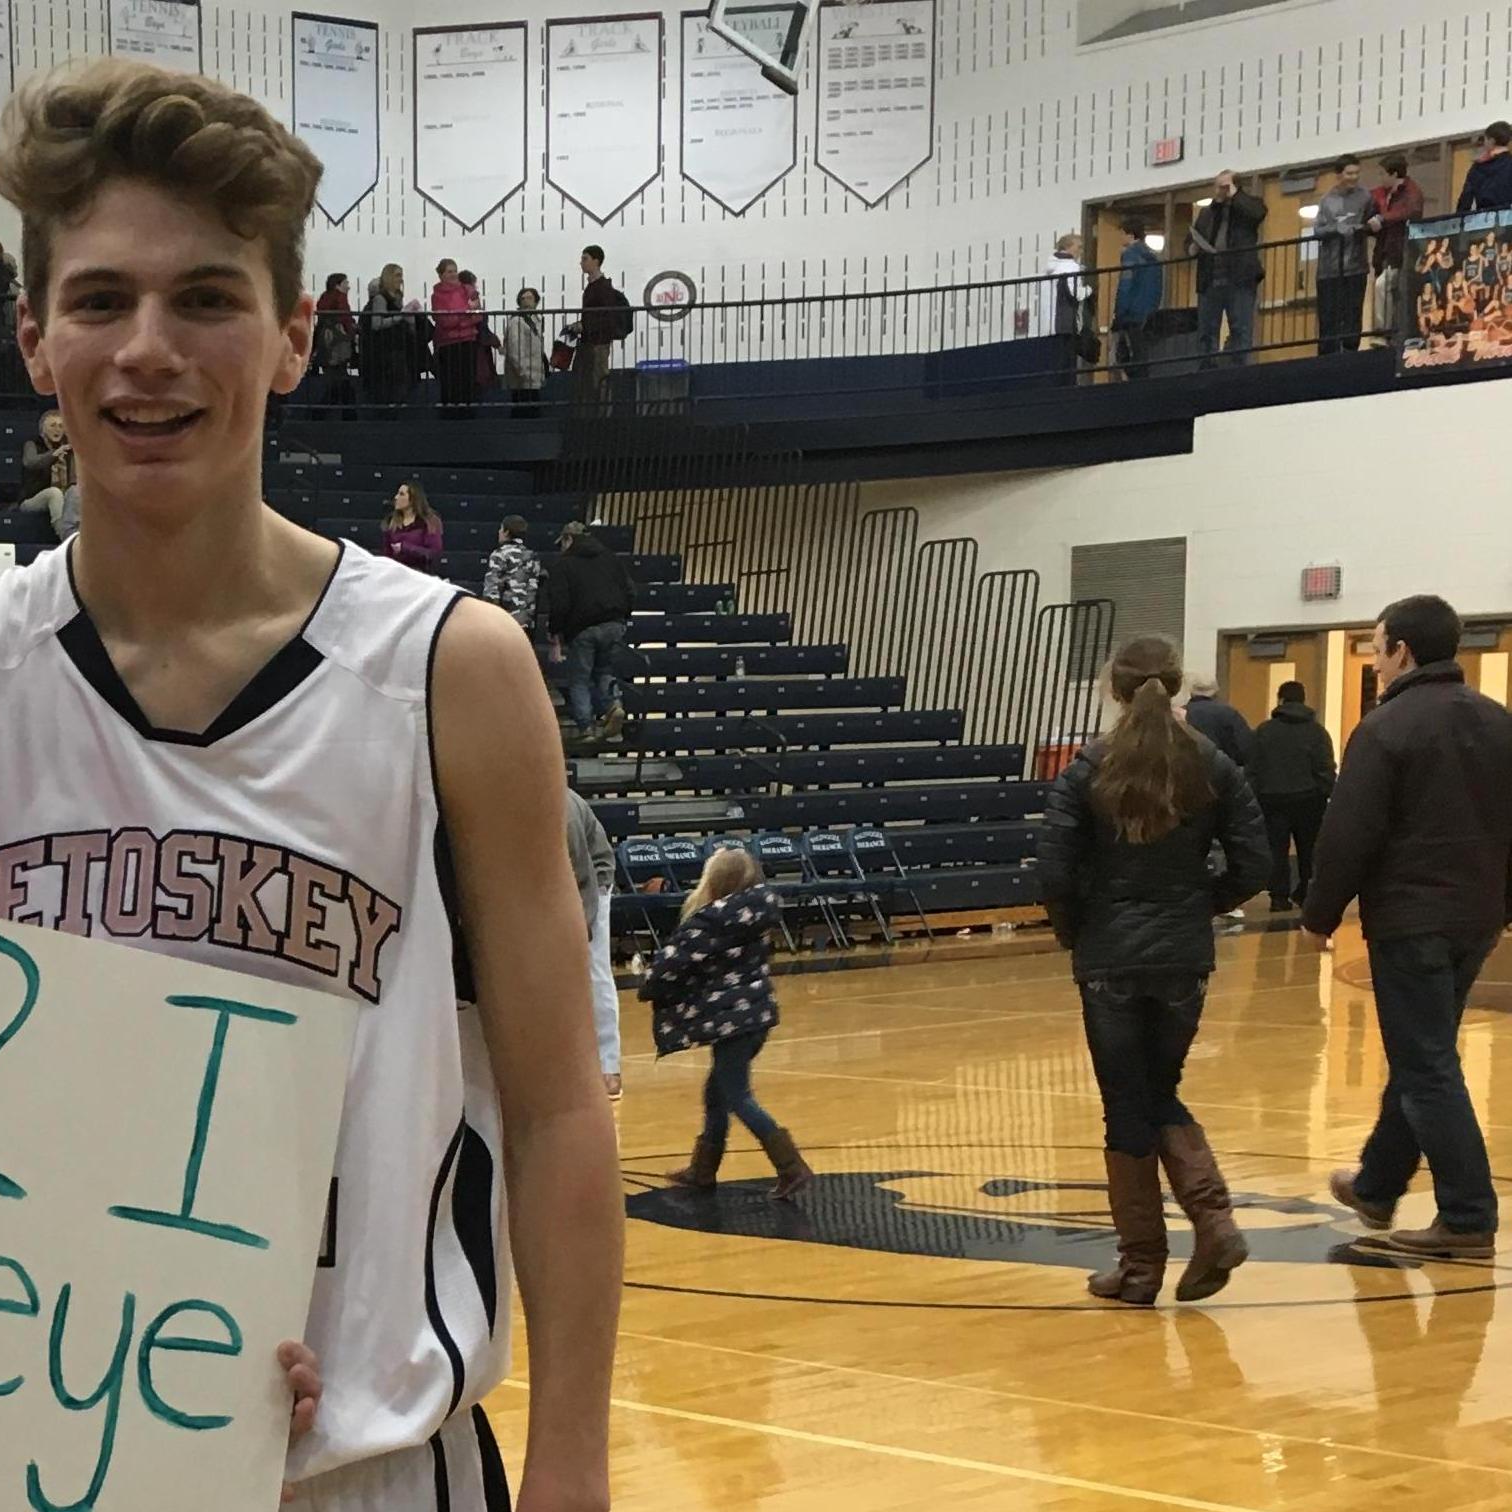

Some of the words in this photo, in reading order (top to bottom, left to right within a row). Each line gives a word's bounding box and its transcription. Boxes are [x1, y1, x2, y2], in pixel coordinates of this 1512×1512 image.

[577, 21, 632, 37] TRACK
[445, 30, 499, 46] TRACK
[108, 995, 298, 1250] I
